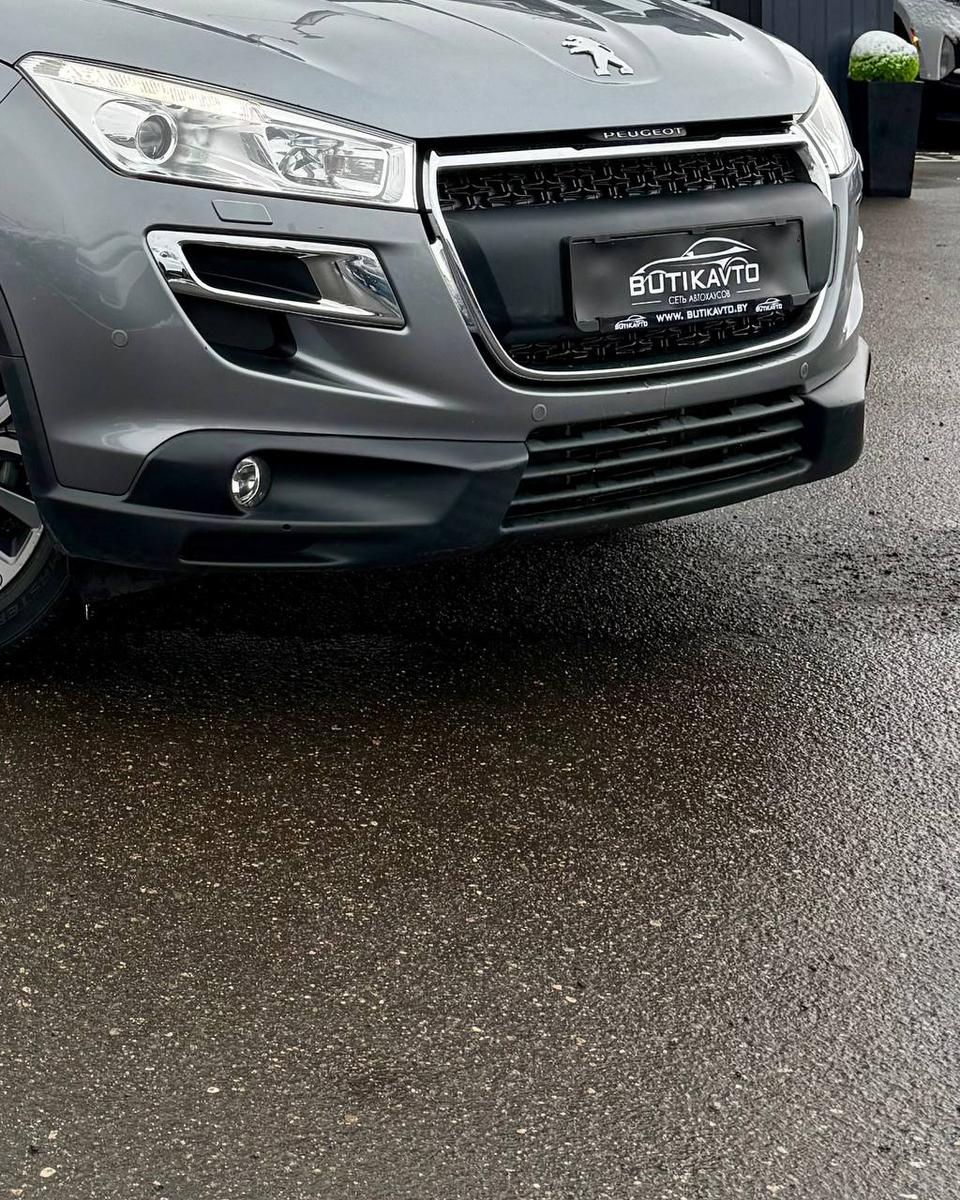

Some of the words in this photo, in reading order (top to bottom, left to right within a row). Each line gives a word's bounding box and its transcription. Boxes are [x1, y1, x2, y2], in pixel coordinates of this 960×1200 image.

[603, 127, 683, 139] PEUGEOT
[629, 263, 760, 297] BUTIKAVTO
[668, 295, 687, 305] СЕТЬ
[689, 289, 731, 304] АВТОХАУСОВ
[686, 303, 748, 320] BUTIKAVTO.BY
